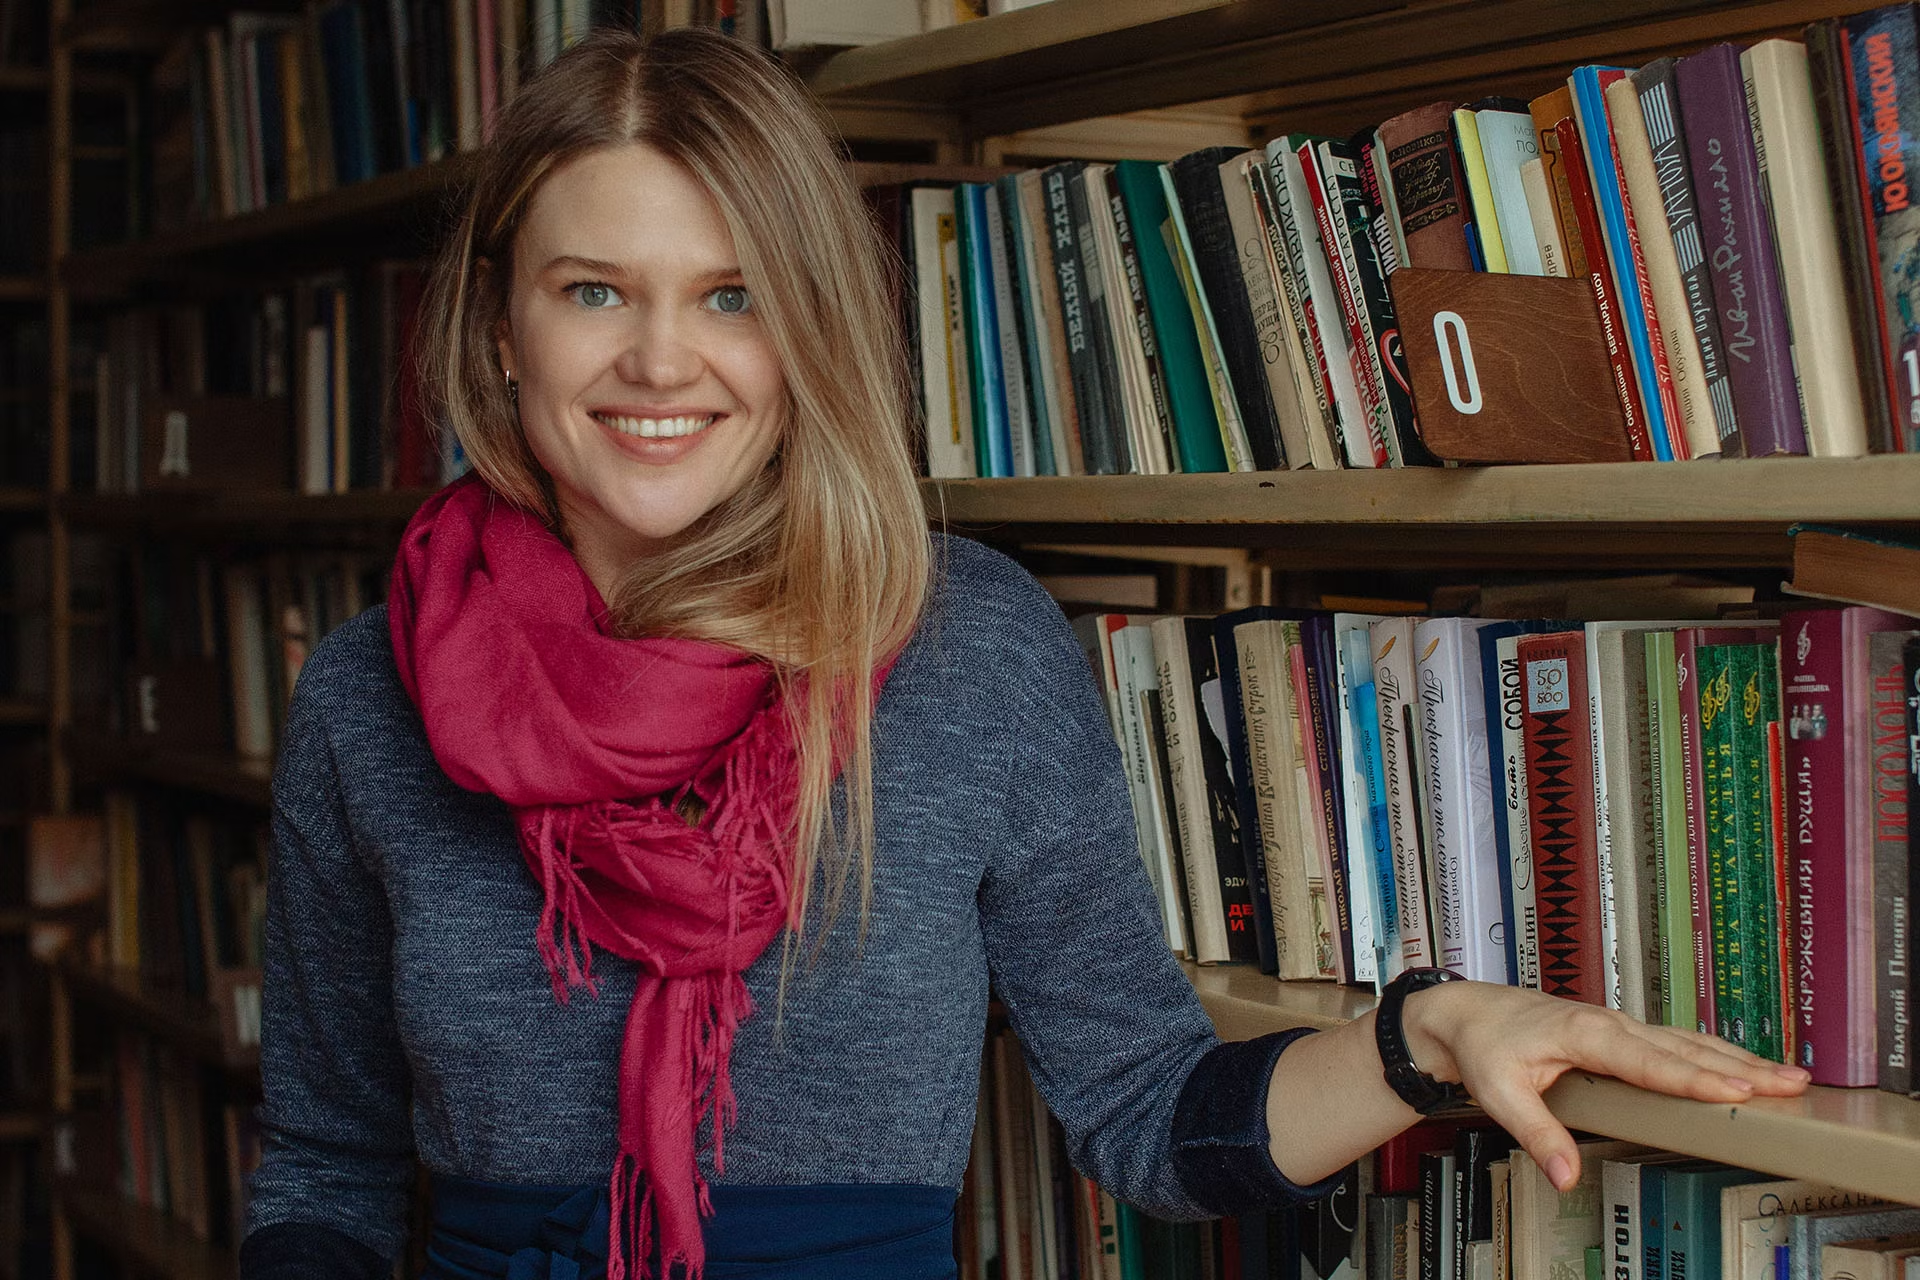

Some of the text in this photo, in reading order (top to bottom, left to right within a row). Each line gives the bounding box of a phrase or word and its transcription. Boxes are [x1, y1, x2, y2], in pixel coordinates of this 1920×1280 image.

[1047, 172, 1074, 250] ХЛЕБ
[1654, 137, 1692, 226] ЗАНОЗА
[1265, 225, 1289, 267] РОМАН
[1315, 204, 1342, 258] дневник
[1057, 259, 1086, 353] БЕЛЫЙ
[1280, 271, 1309, 332] ЖЕНСКИЙ
[1330, 260, 1358, 328] Семейный
[1350, 283, 1376, 347] НОСОВ
[1590, 271, 1608, 299] ШОУ
[1598, 300, 1619, 356] БЕРНАРД
[1668, 328, 1690, 384] Обухова
[1364, 351, 1390, 415] СЕРГЕЙ
[1614, 363, 1638, 427] Образцова
[1162, 660, 1179, 724] ОЛЕНЬ
[1500, 657, 1523, 731] СОБОЙ
[1537, 668, 1562, 687] 50
[1537, 690, 1564, 705] 500
[1505, 754, 1518, 811] быть
[1651, 746, 1661, 810] ВЫЖИВАНИЯ
[1874, 664, 1908, 843] ПОСОЛОНЬ
[1255, 801, 1284, 853] Тайны
[1307, 665, 1349, 932] НИКОЛАЙ ПЕРЕЯСЛОВ СТИХОТВОРЕНИЯ
[1379, 666, 1412, 930] Прекрасная толстушка
[1421, 668, 1453, 941] Прекрасная толстушка
[1590, 695, 1609, 930] Виктор ПЕТРОВ КОЛЧАН СИБИРСКИХ СТРЕЛ
[1654, 812, 1663, 837] ПУТЬ
[1680, 713, 1699, 917] ПРОГУЛКИ ДЛЯ ВЛЮБЛЕННЫХ
[1750, 757, 1762, 865] ЛАНСКАЯ
[1405, 848, 1419, 929] Юрий Перов
[1449, 856, 1463, 940] Юрий Перов
[1656, 842, 1667, 908] СОЛИДАРНЫЙ
[1706, 746, 1727, 996] ПОГИБЕЛЬНОЕ СЧАСТЬЕ
[1719, 742, 1744, 1003] ДЕВА НАТАЛЬЯ
[1230, 919, 1245, 933] И
[1888, 896, 1908, 1069] Валерий Писигин
[1422, 1169, 1437, 1253] спишет»
[1456, 1172, 1465, 1219] Вадим
